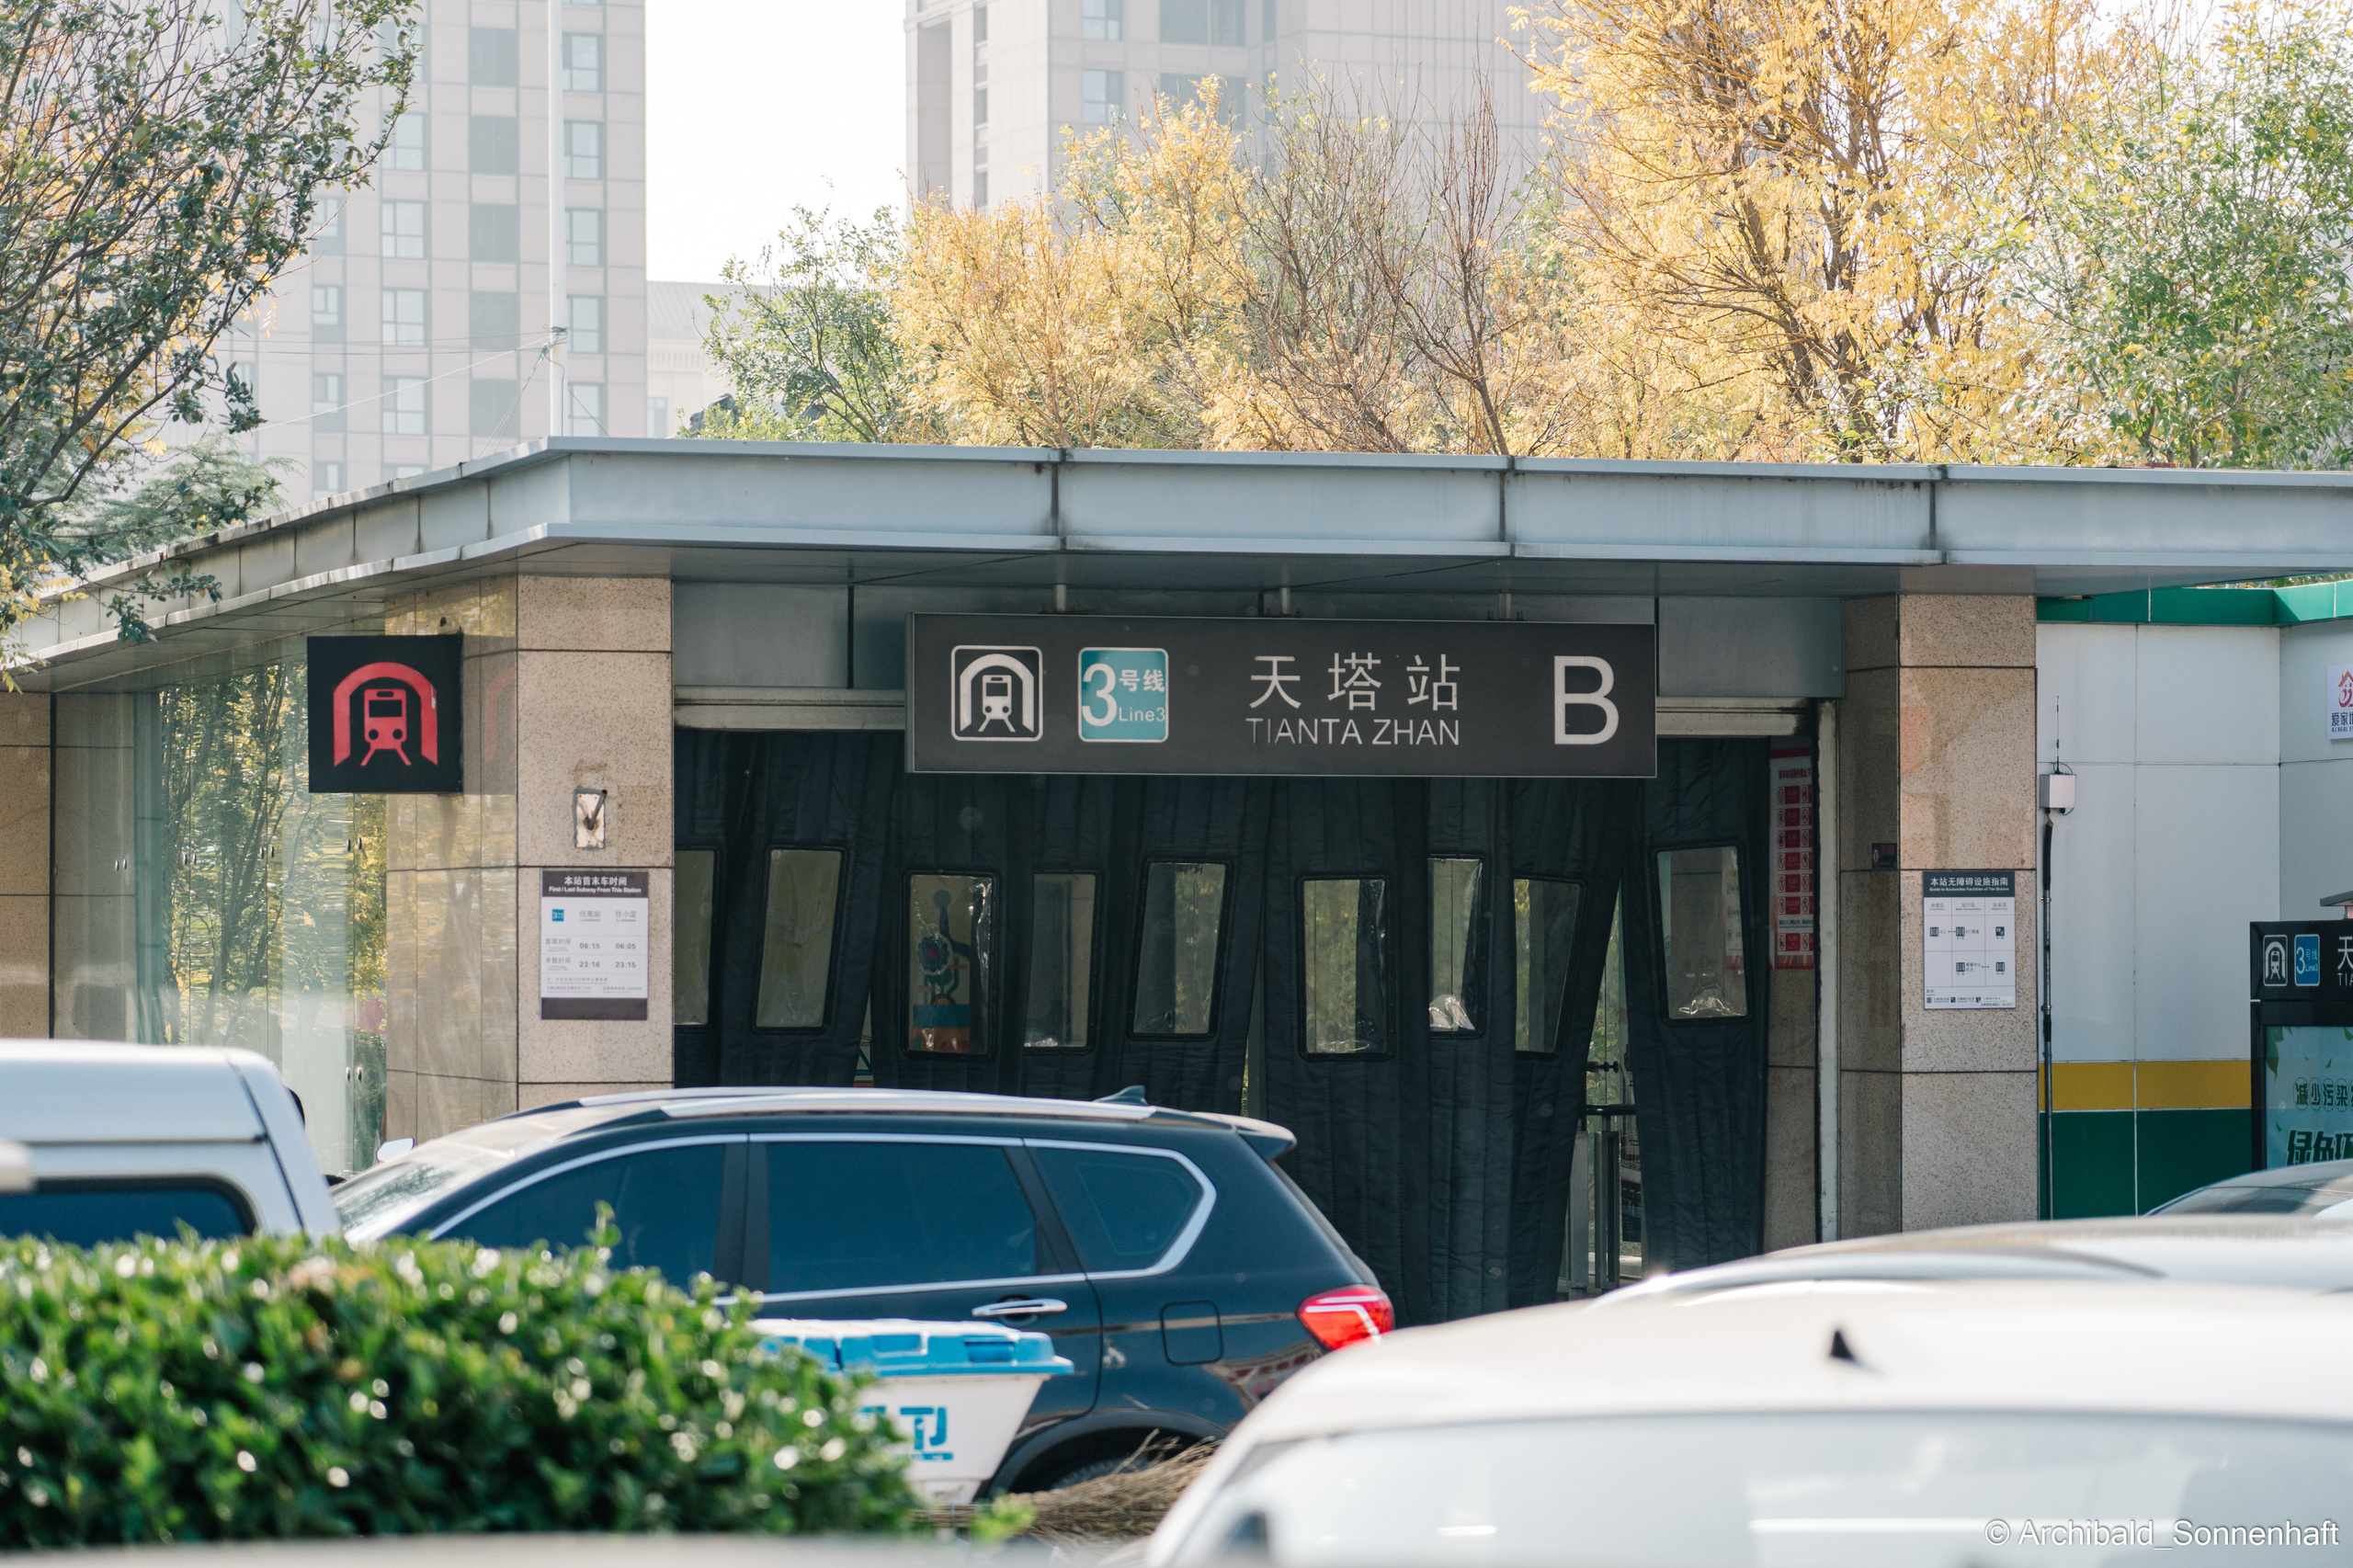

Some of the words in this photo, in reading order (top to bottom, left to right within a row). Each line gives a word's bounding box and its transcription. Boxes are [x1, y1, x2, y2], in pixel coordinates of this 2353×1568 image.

[1119, 669, 1165, 692] 号线
[1249, 652, 1461, 711] 天塔站
[1553, 655, 1620, 745] B
[1119, 707, 1165, 722] Line3
[1245, 718, 1363, 744] TIANTA
[1371, 719, 1460, 745] ZHAN
[563, 875, 628, 886] 本站首末车时间
[575, 886, 597, 894] Subway
[1930, 877, 2008, 887] 本站无障碍设施指南
[2337, 937, 2353, 971] 天
[2295, 1083, 2353, 1107] 减少污染
